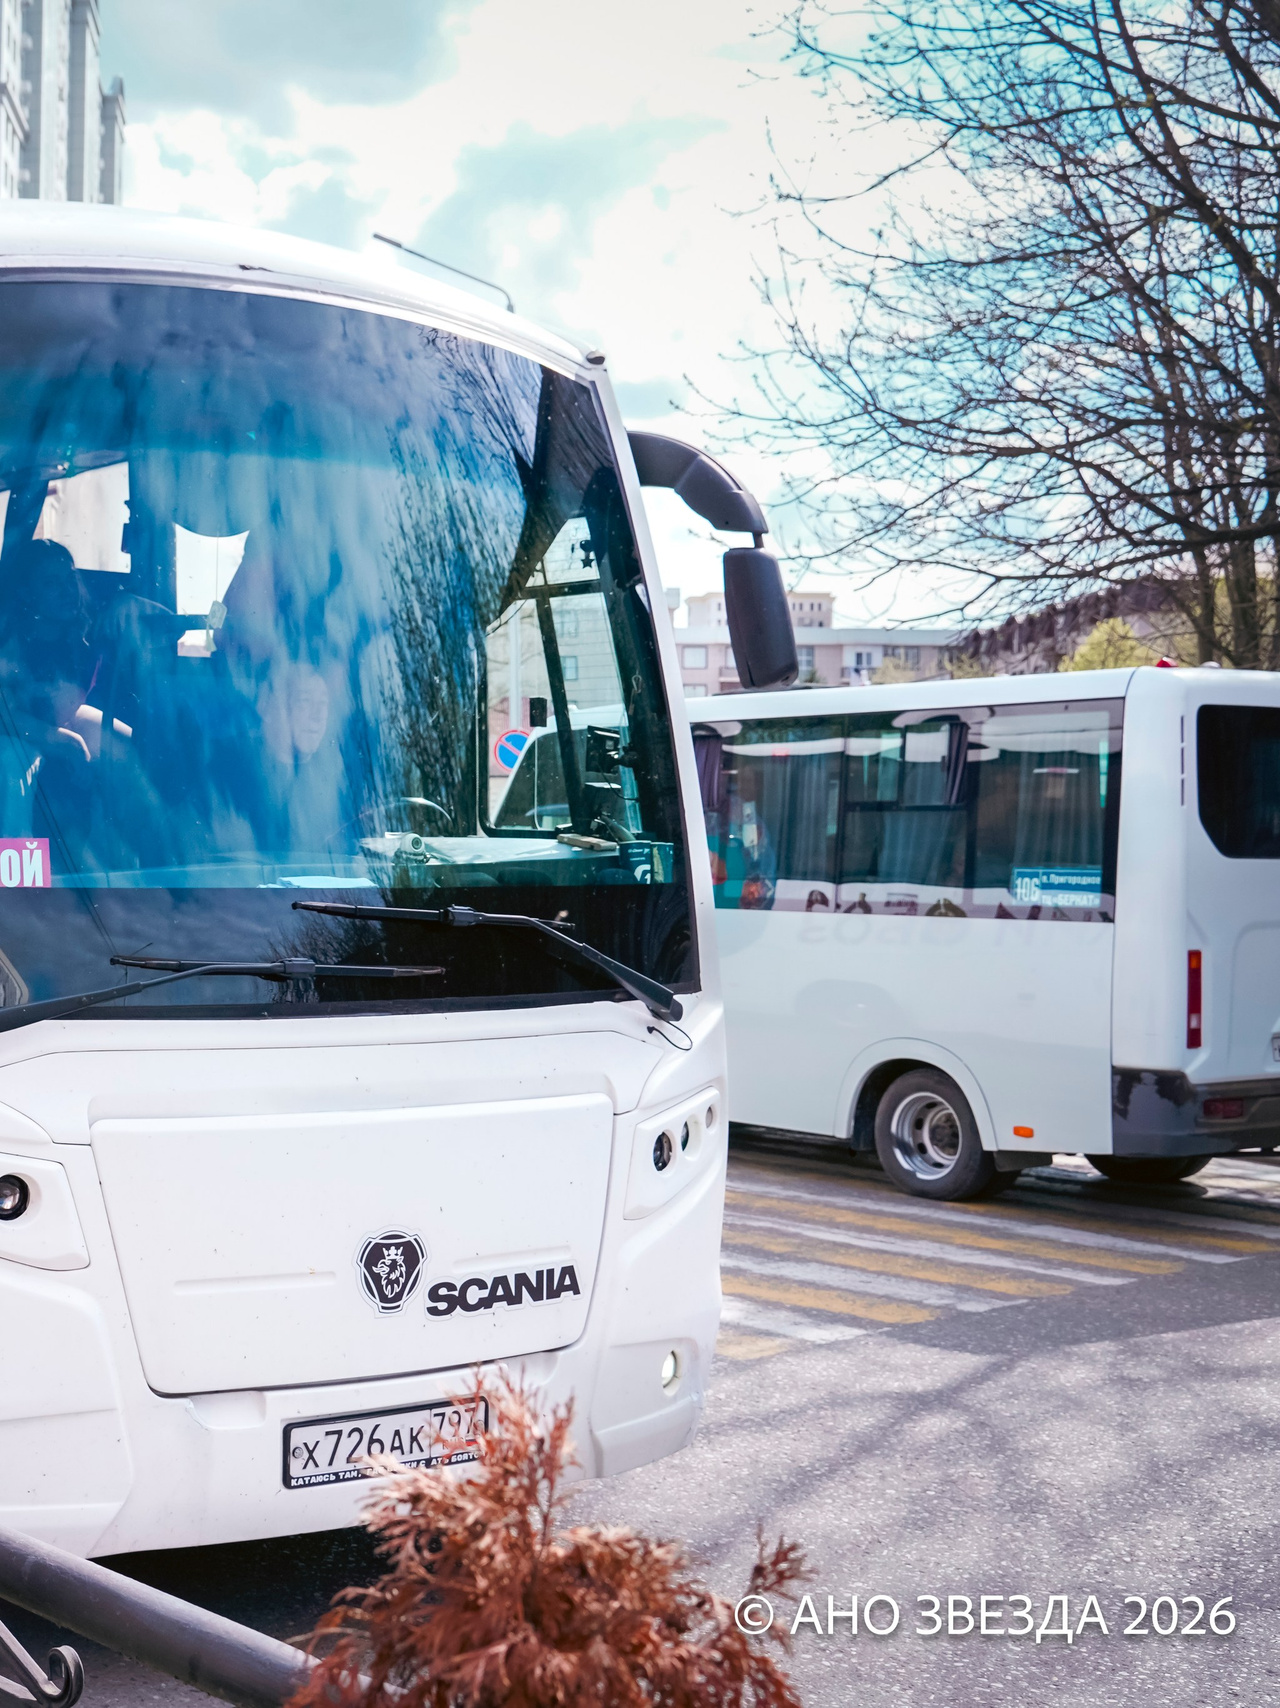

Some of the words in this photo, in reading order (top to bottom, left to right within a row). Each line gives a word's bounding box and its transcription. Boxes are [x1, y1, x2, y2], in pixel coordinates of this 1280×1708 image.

[1015, 876, 1040, 902] 106
[426, 1264, 581, 1317] SCANIA
[291, 1474, 336, 1487] КАТАЮСЬ
